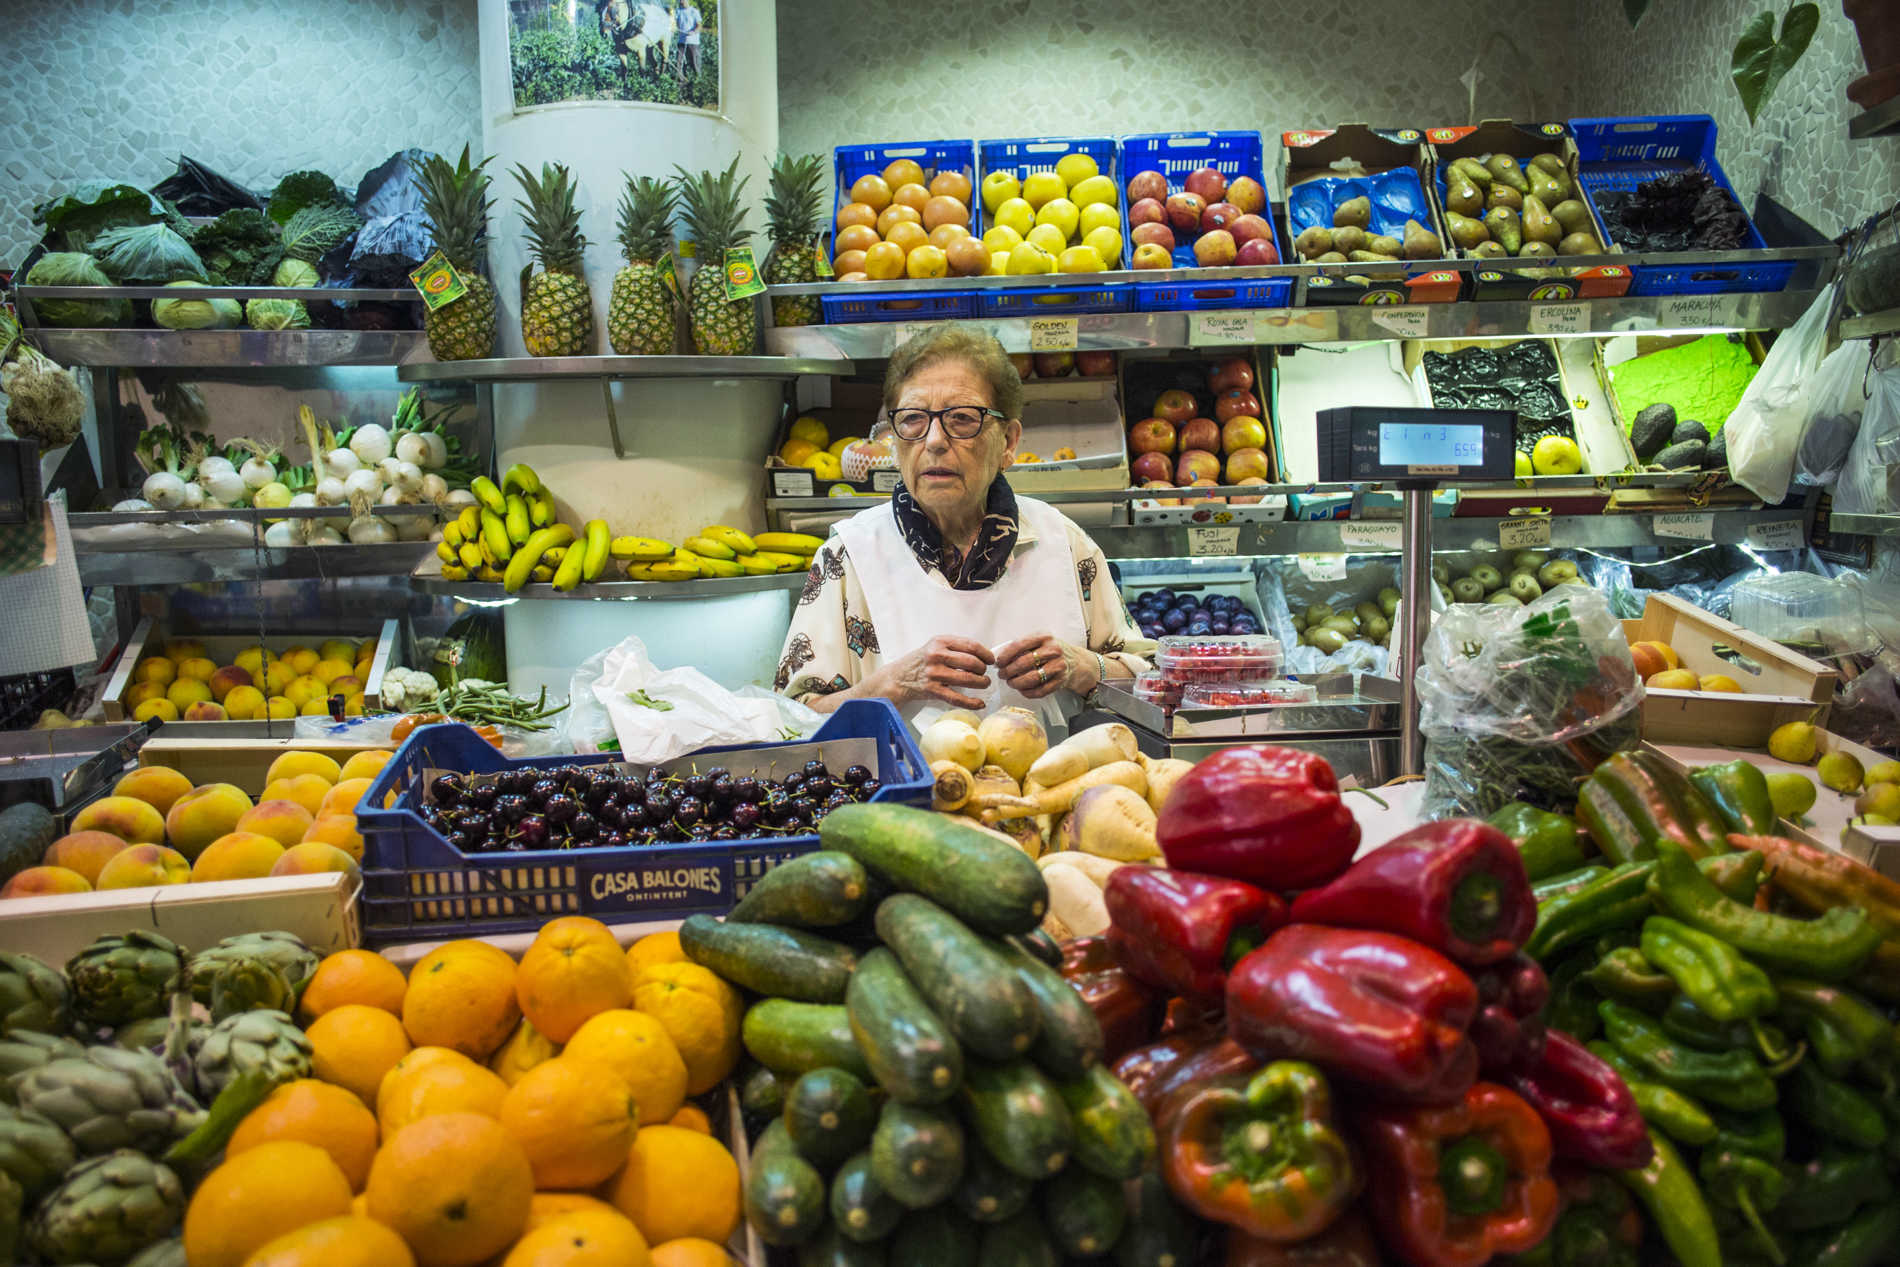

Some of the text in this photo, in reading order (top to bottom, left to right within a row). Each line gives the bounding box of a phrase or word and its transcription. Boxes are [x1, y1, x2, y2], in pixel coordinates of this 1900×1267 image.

[1032, 321, 1068, 330] GOLDEN
[1347, 524, 1397, 534] PARAGUAYO
[591, 867, 721, 900] CASA BALONES
[626, 890, 688, 902] ONTINYENT
